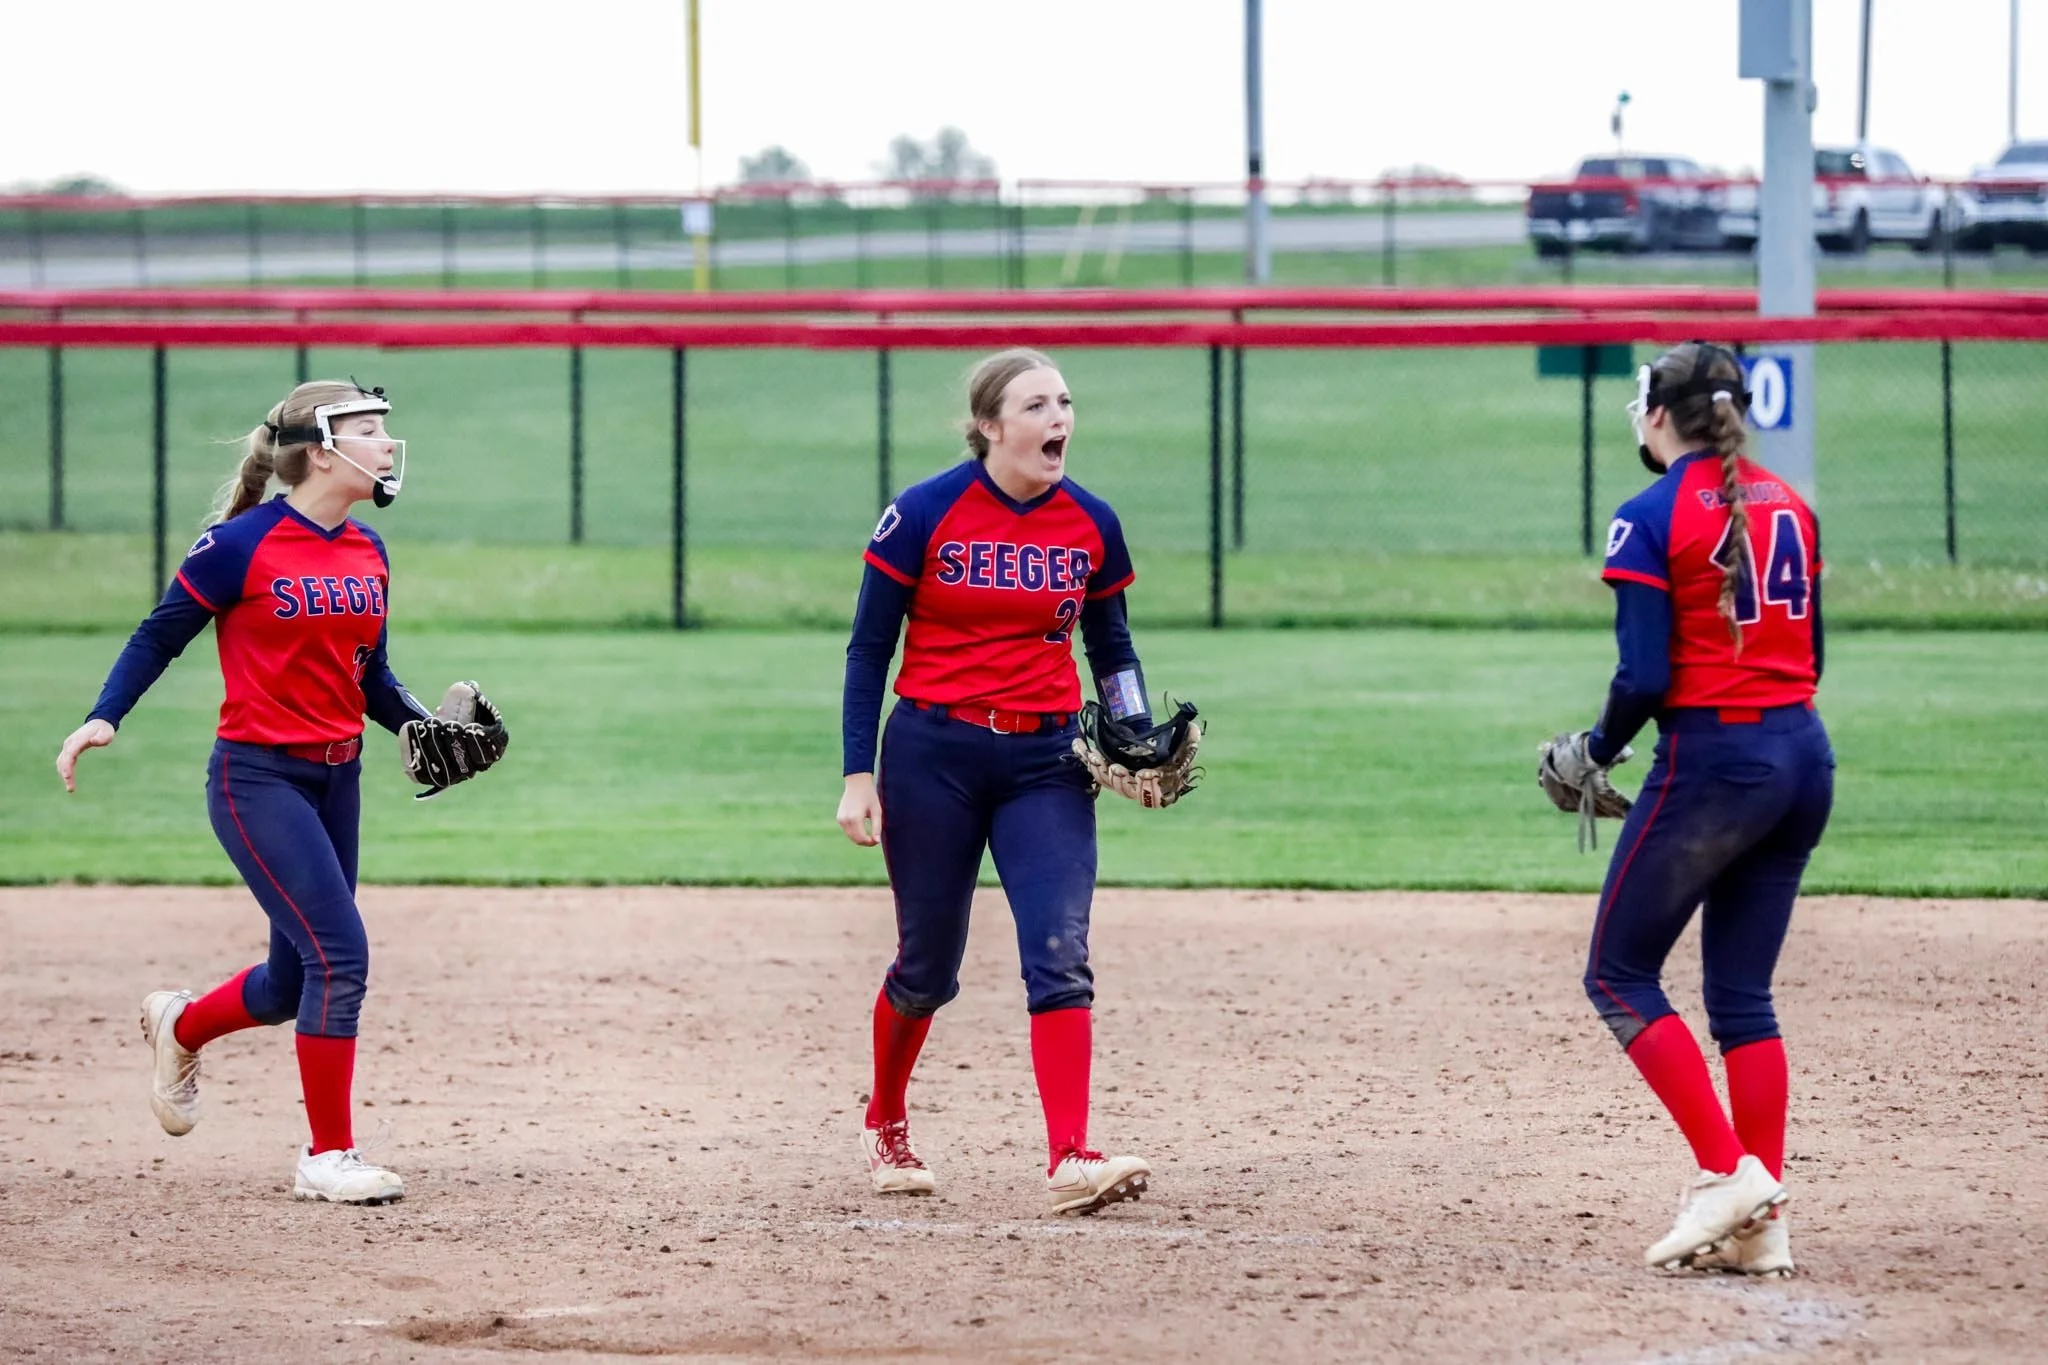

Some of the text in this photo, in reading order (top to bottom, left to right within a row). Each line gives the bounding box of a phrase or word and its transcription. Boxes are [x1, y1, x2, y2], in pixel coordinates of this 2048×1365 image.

[937, 541, 1092, 592] SEEGER
[1709, 510, 1810, 624] 14
[271, 576, 385, 619] SEEGE
[1044, 594, 1086, 644] 2
